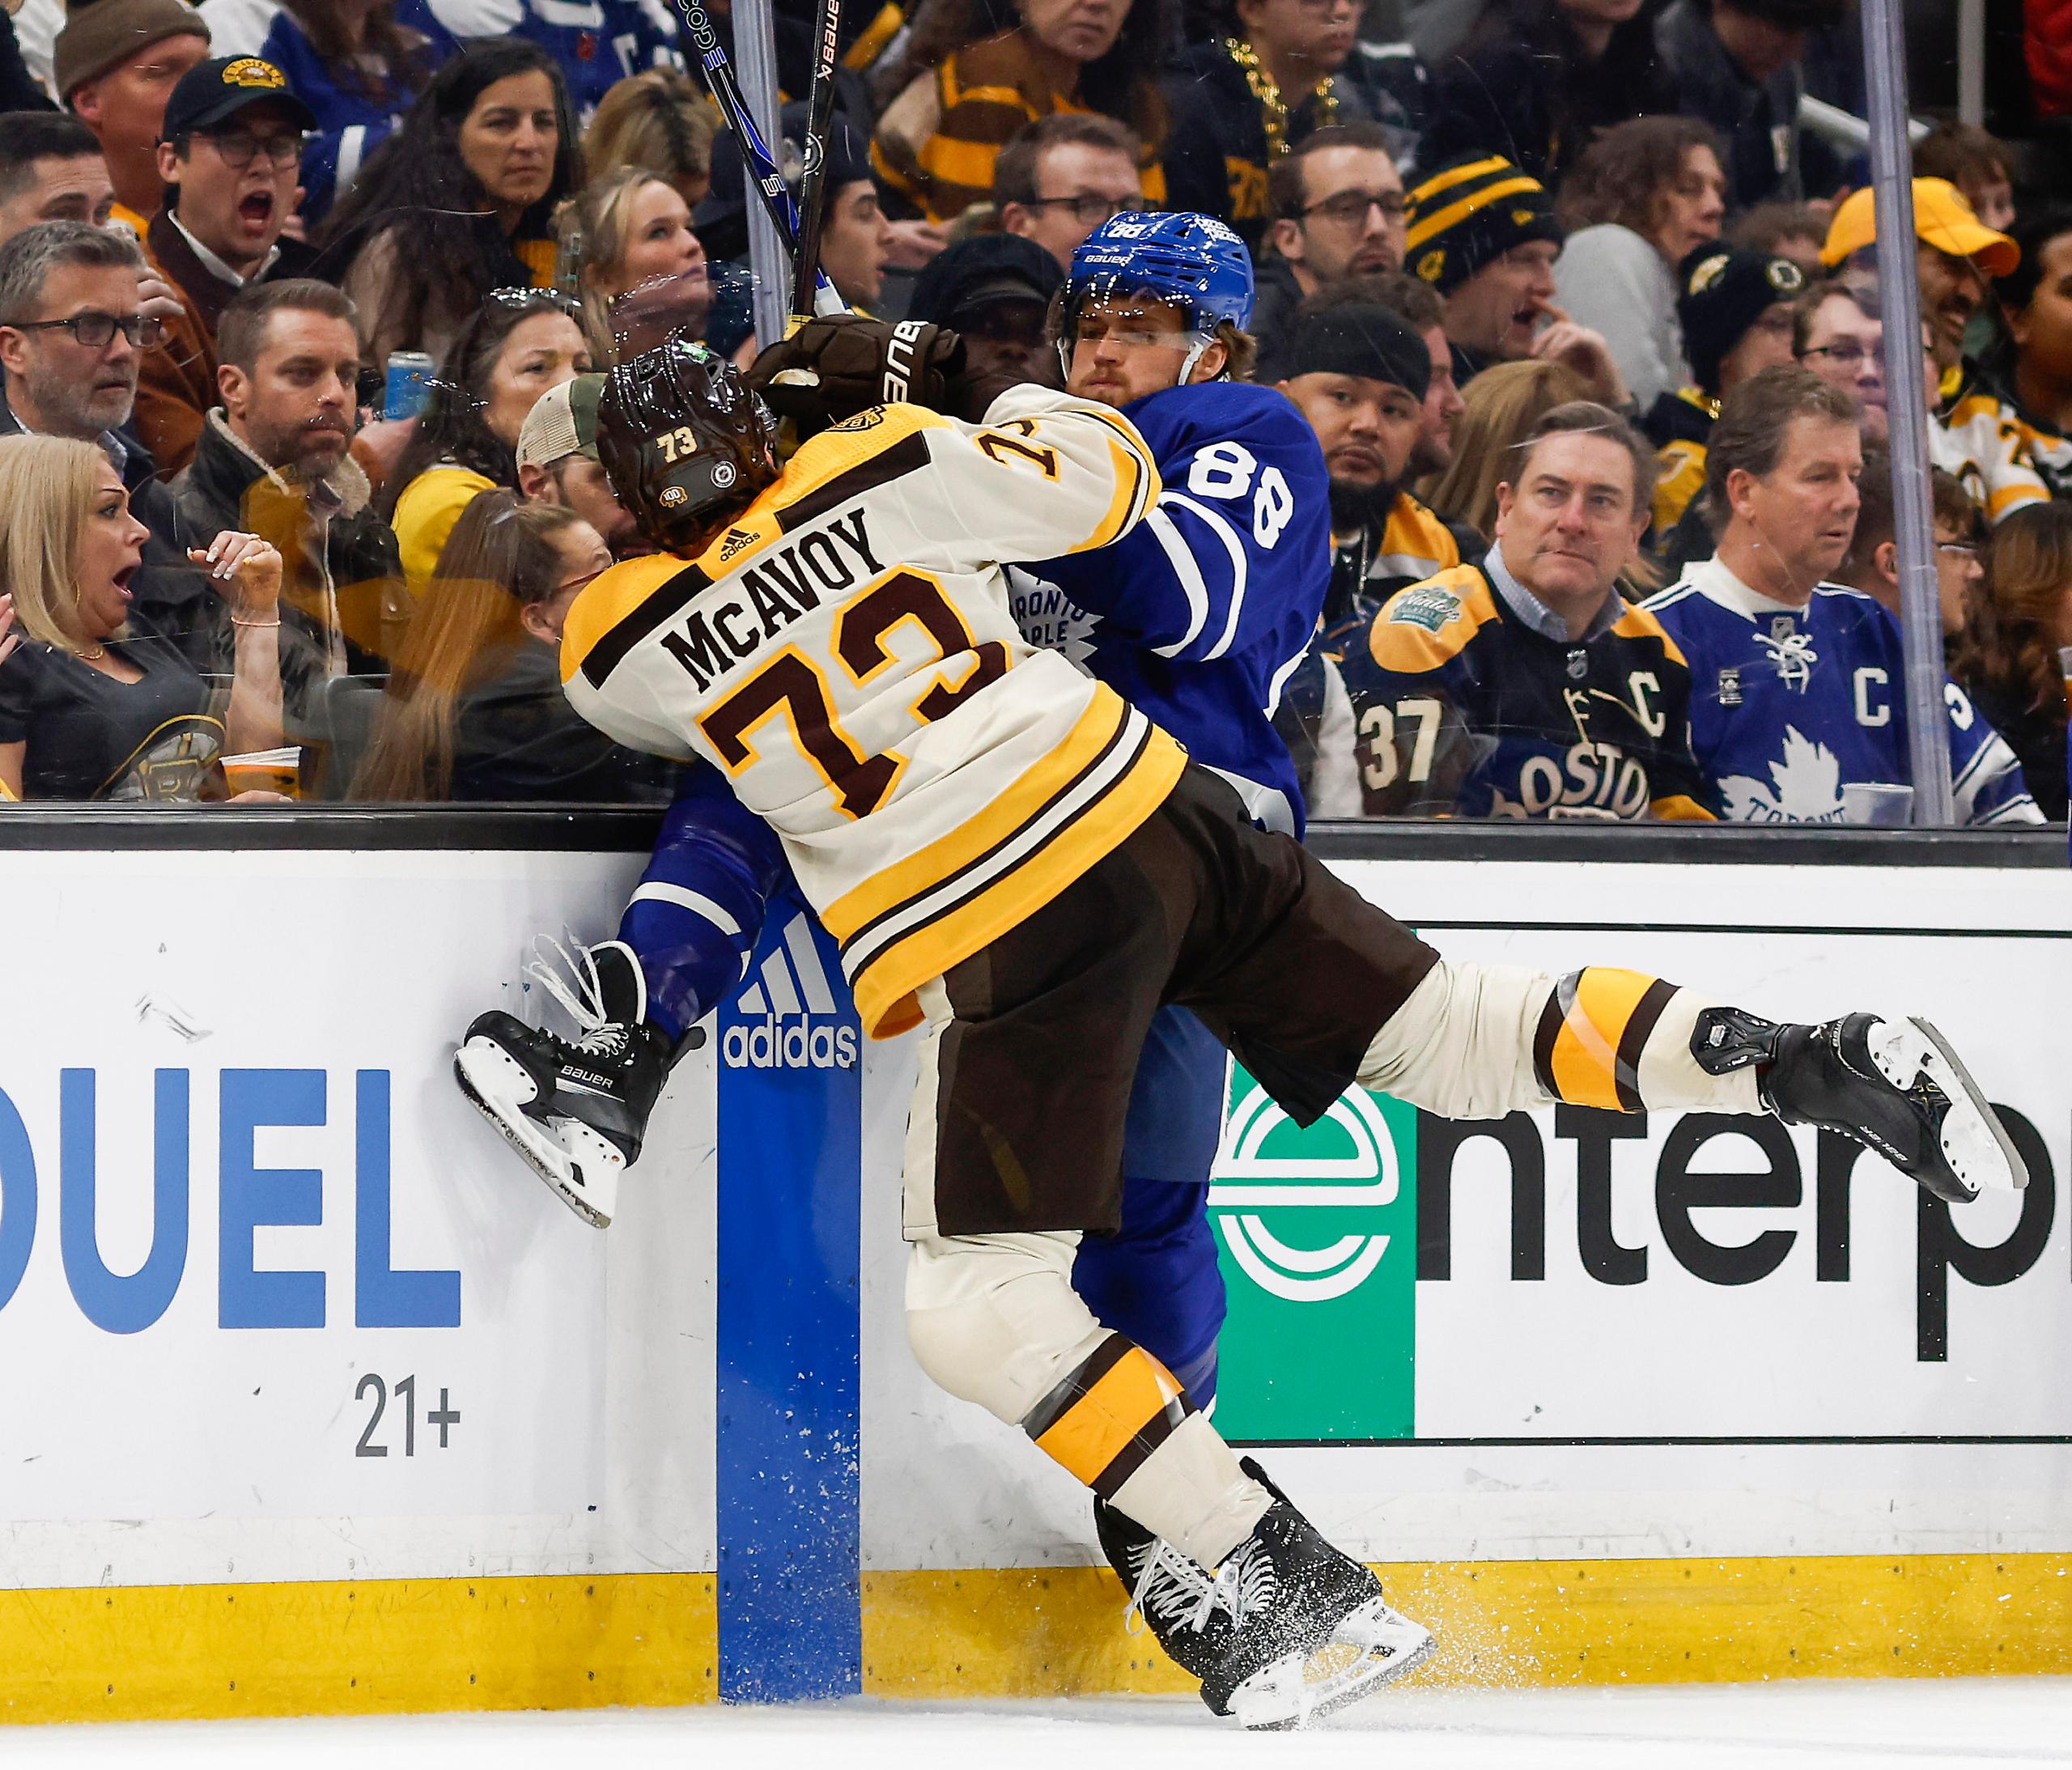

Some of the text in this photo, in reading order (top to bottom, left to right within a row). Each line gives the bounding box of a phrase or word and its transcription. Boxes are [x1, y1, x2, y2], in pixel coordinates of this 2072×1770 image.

[1084, 255, 1132, 265] BAUER
[656, 426, 698, 464] 73
[1187, 441, 1293, 550] 88
[720, 532, 761, 562] adidas
[694, 563, 1013, 821] 73
[1628, 671, 1666, 738] C
[1853, 667, 1891, 727] C
[1359, 698, 1442, 791] 37
[723, 1013, 858, 1069] adidas
[560, 1063, 614, 1089] BAUER
[1207, 1082, 2072, 1362] enterp
[355, 1373, 461, 1458] 21+
